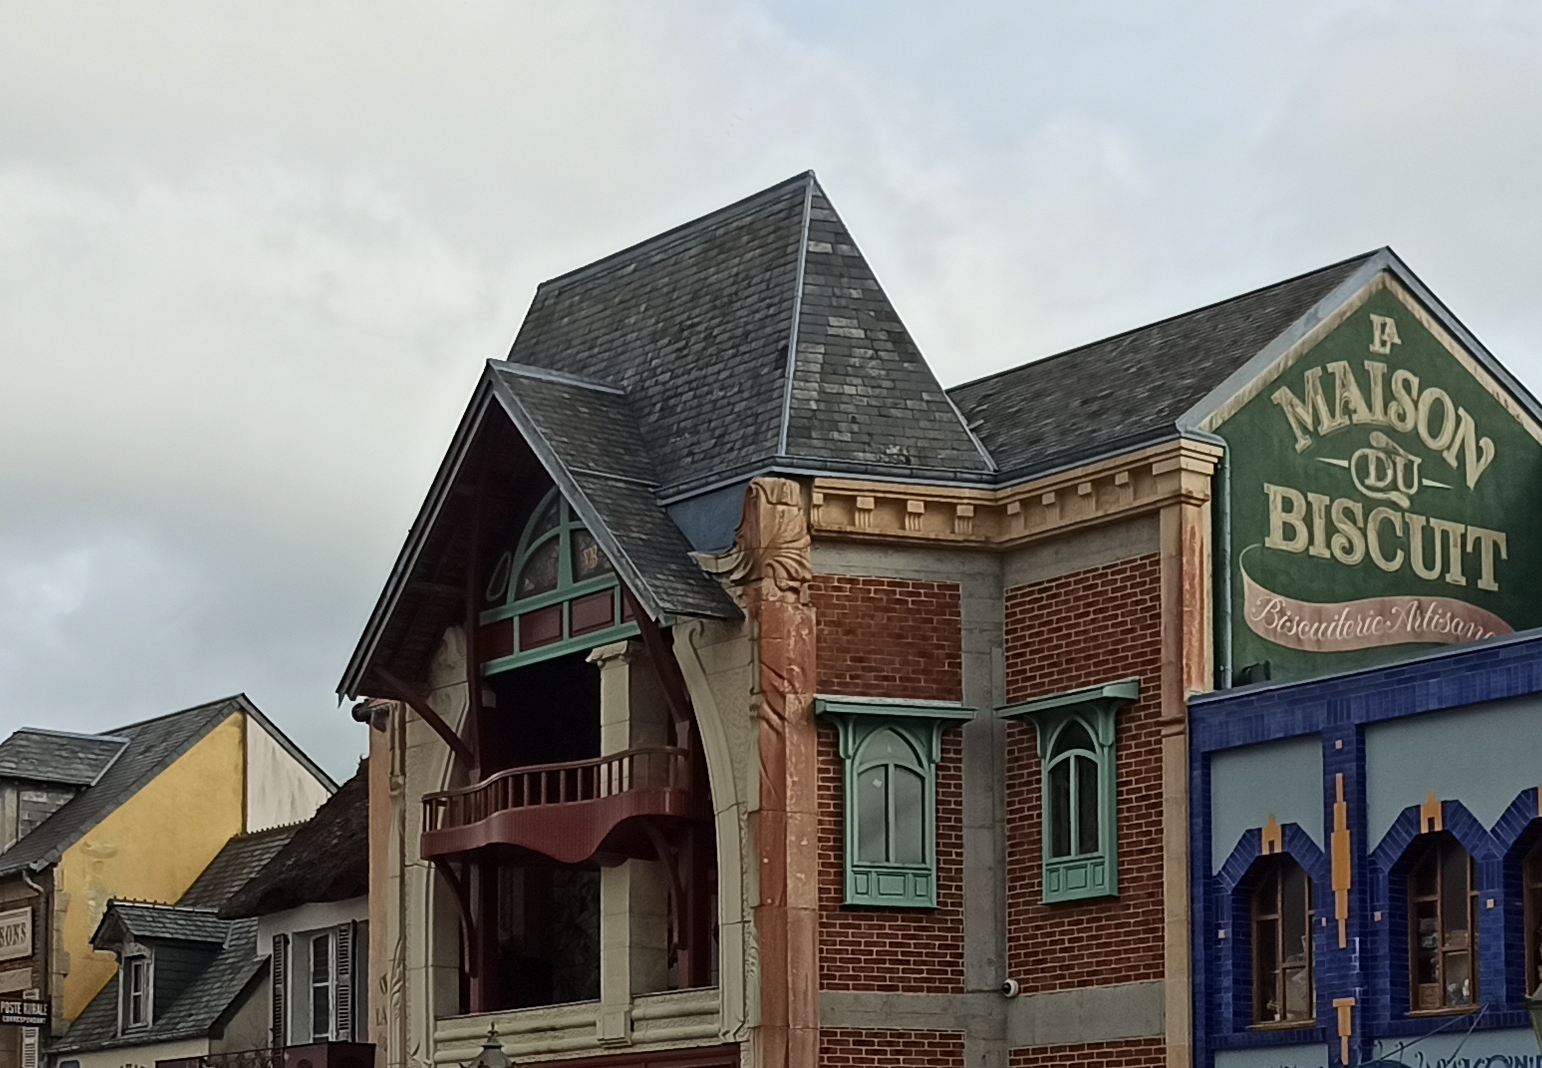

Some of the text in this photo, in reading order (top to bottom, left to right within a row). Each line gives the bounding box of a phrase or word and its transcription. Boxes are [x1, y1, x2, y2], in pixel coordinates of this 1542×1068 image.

[1369, 313, 1401, 354] LA
[1270, 360, 1495, 491] MAISON
[1351, 431, 1422, 509] DU
[1263, 482, 1508, 591] BISCUIT
[1250, 596, 1384, 641] Biscuiterie
